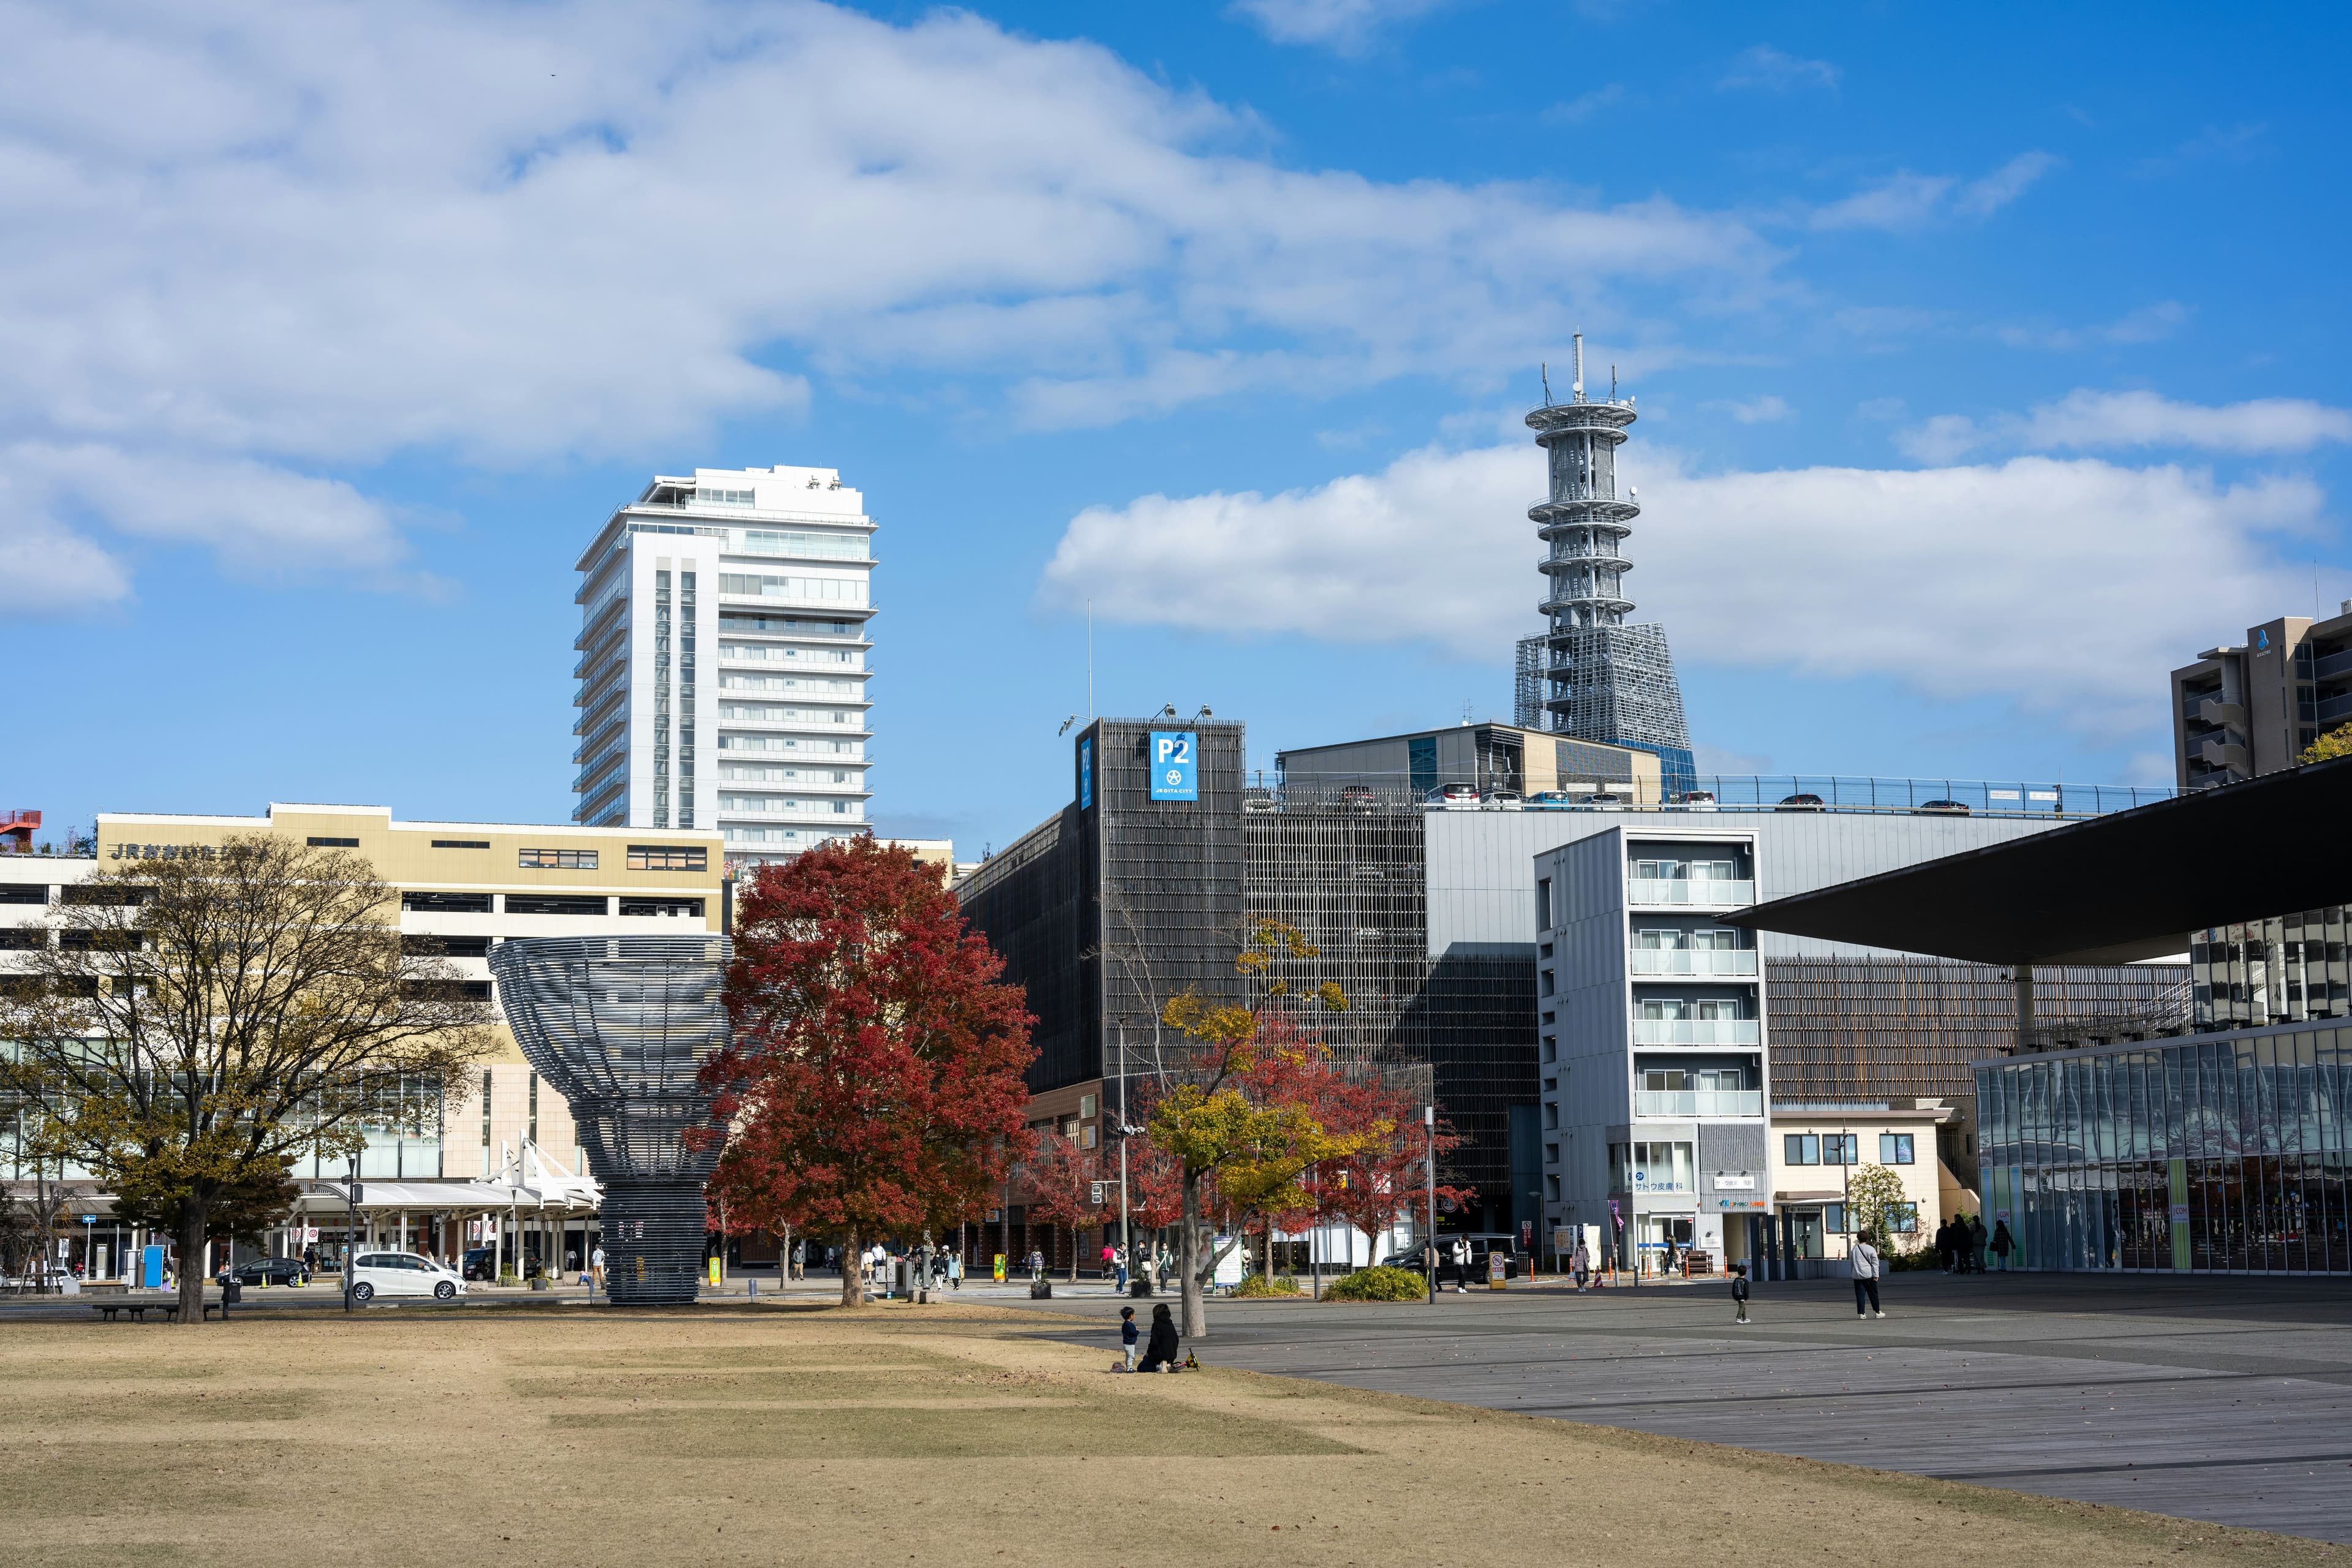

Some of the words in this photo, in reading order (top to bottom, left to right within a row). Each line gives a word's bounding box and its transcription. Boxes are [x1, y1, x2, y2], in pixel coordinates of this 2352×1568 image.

[1158, 739, 1189, 763] P2
[1083, 747, 1089, 773] P2
[1635, 1182, 1683, 1191] サトウ皮膚科
[1579, 1226, 1583, 1237] P
